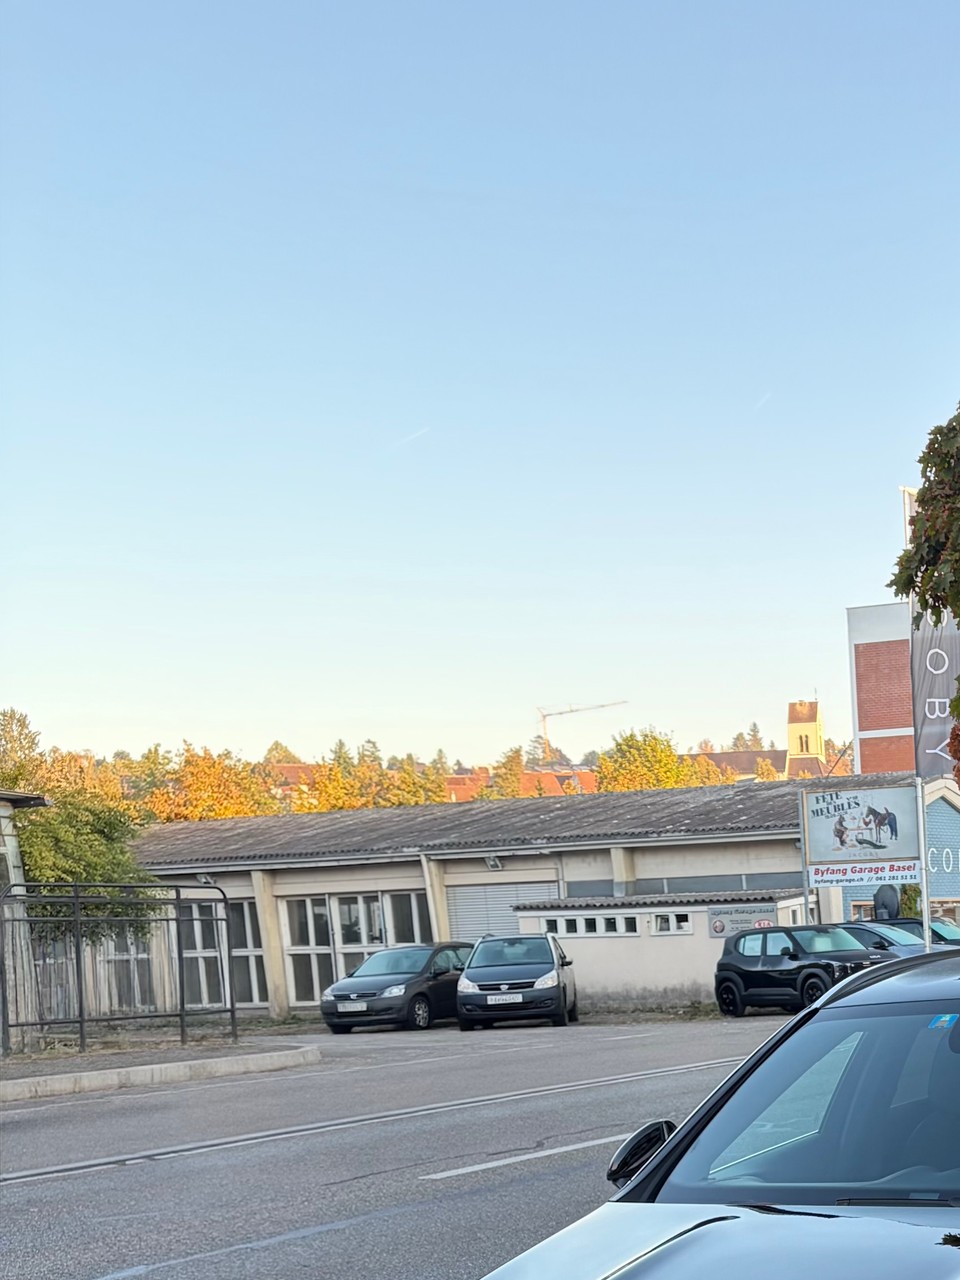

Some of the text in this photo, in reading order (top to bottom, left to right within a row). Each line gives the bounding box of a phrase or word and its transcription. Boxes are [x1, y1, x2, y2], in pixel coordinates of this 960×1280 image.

[811, 801, 860, 817] MEUBLES
[814, 863, 916, 877] Byfang Garage Basel
